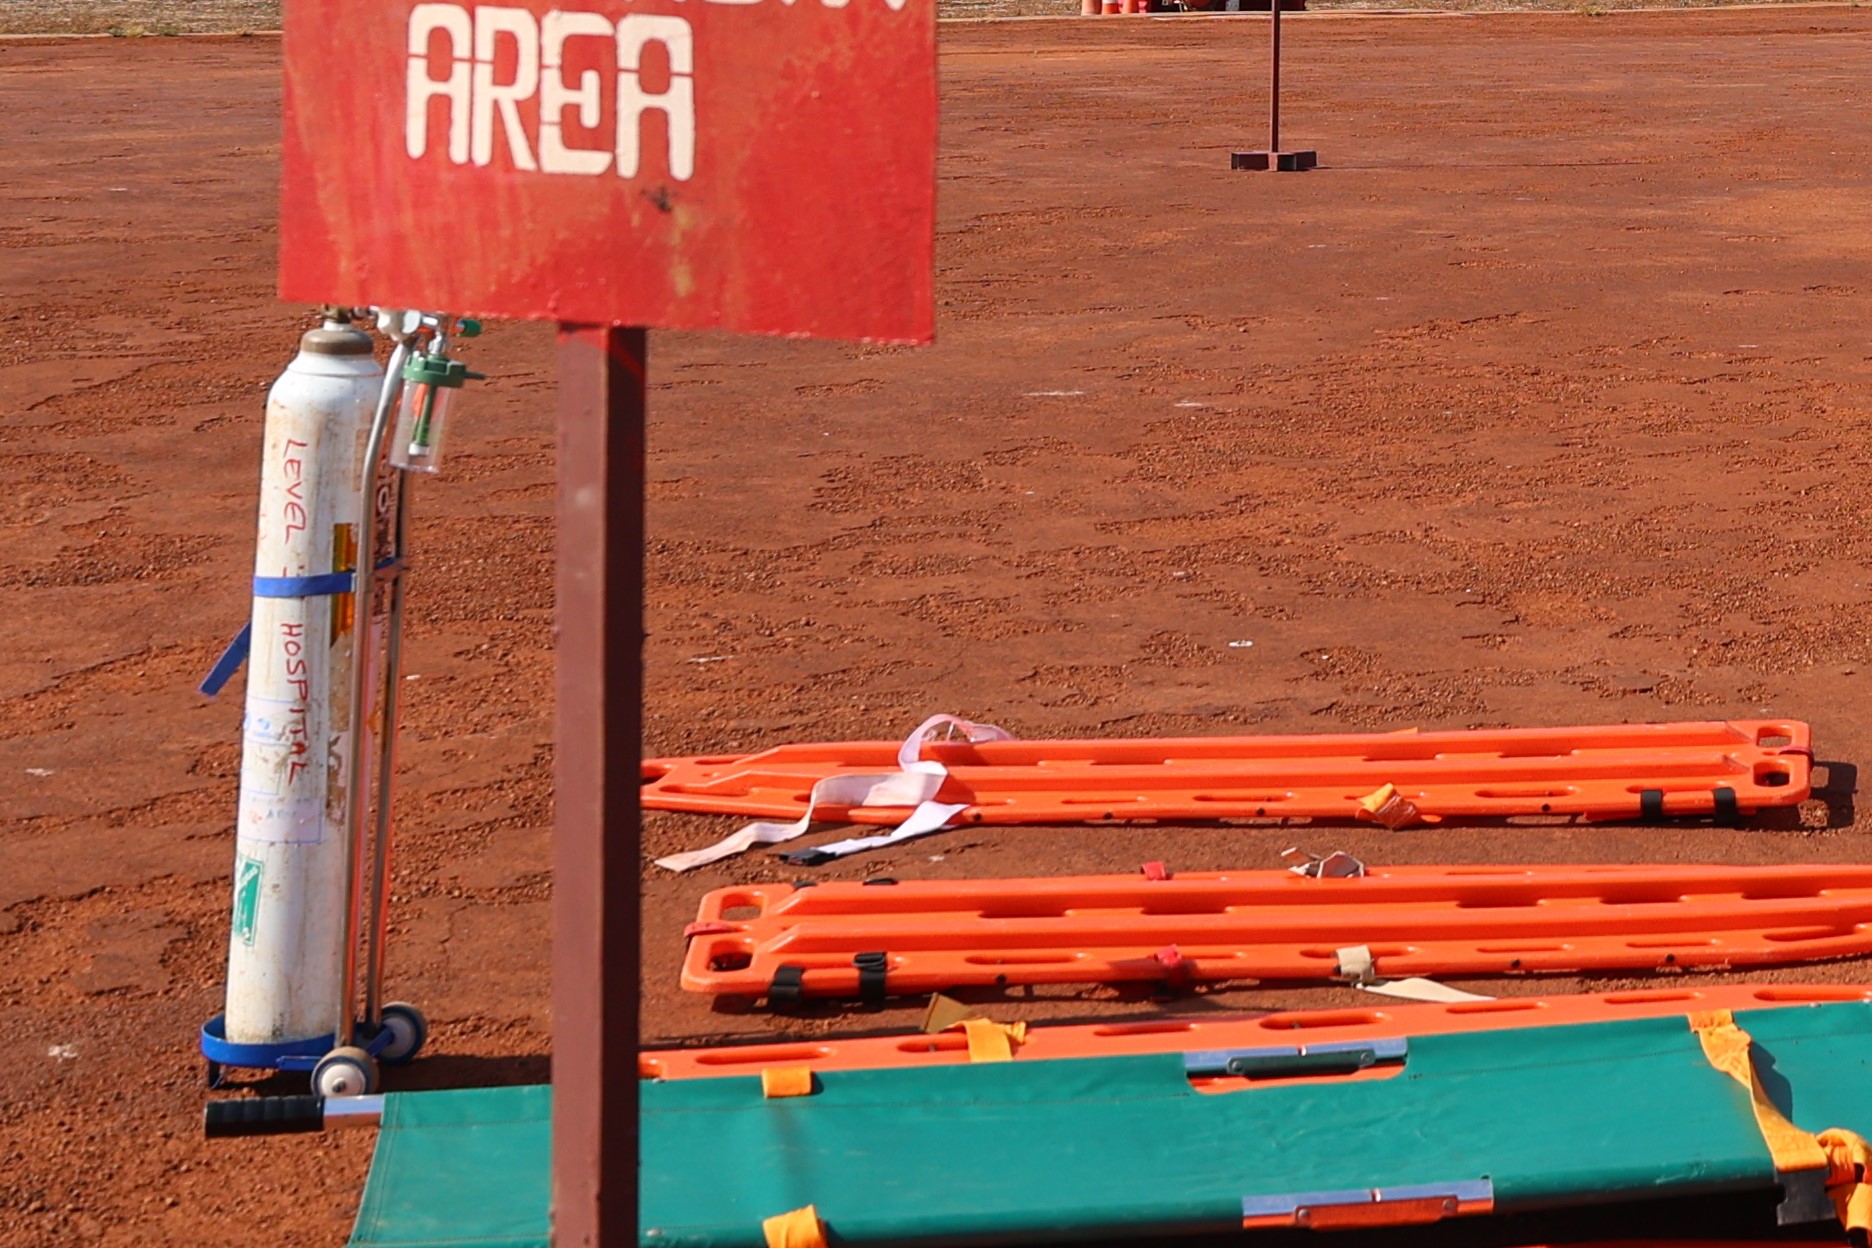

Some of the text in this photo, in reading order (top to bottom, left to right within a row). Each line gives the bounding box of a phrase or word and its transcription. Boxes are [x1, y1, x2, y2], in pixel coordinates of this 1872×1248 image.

[405, 3, 695, 181] AREA
[283, 438, 308, 545] LEVEL
[280, 623, 310, 787] HOSPITAL
